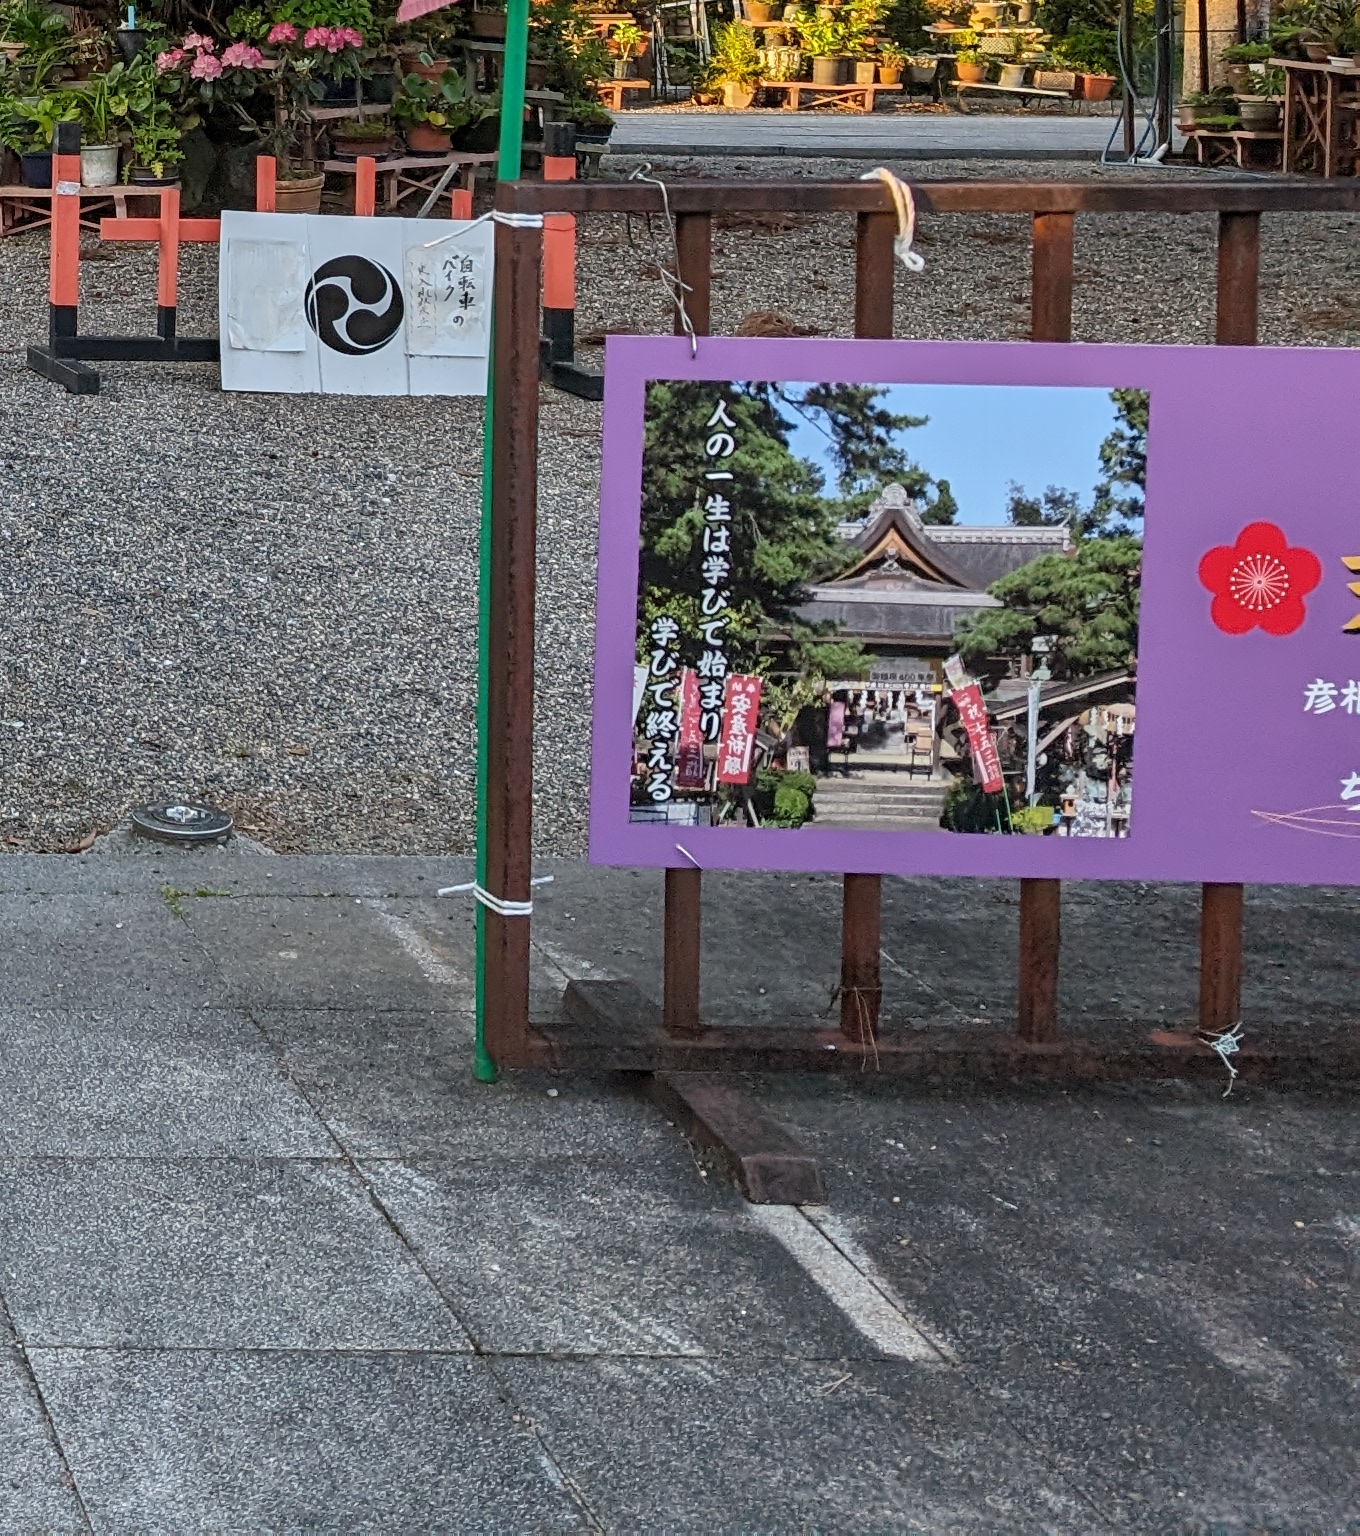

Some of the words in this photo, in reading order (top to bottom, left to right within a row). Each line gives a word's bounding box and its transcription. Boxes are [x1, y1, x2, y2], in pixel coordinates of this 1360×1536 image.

[442, 255, 460, 302] バイク
[452, 255, 476, 327] 自転車の
[697, 399, 736, 741] 人の一生は学びで始まり
[646, 616, 680, 801] 学びで終える
